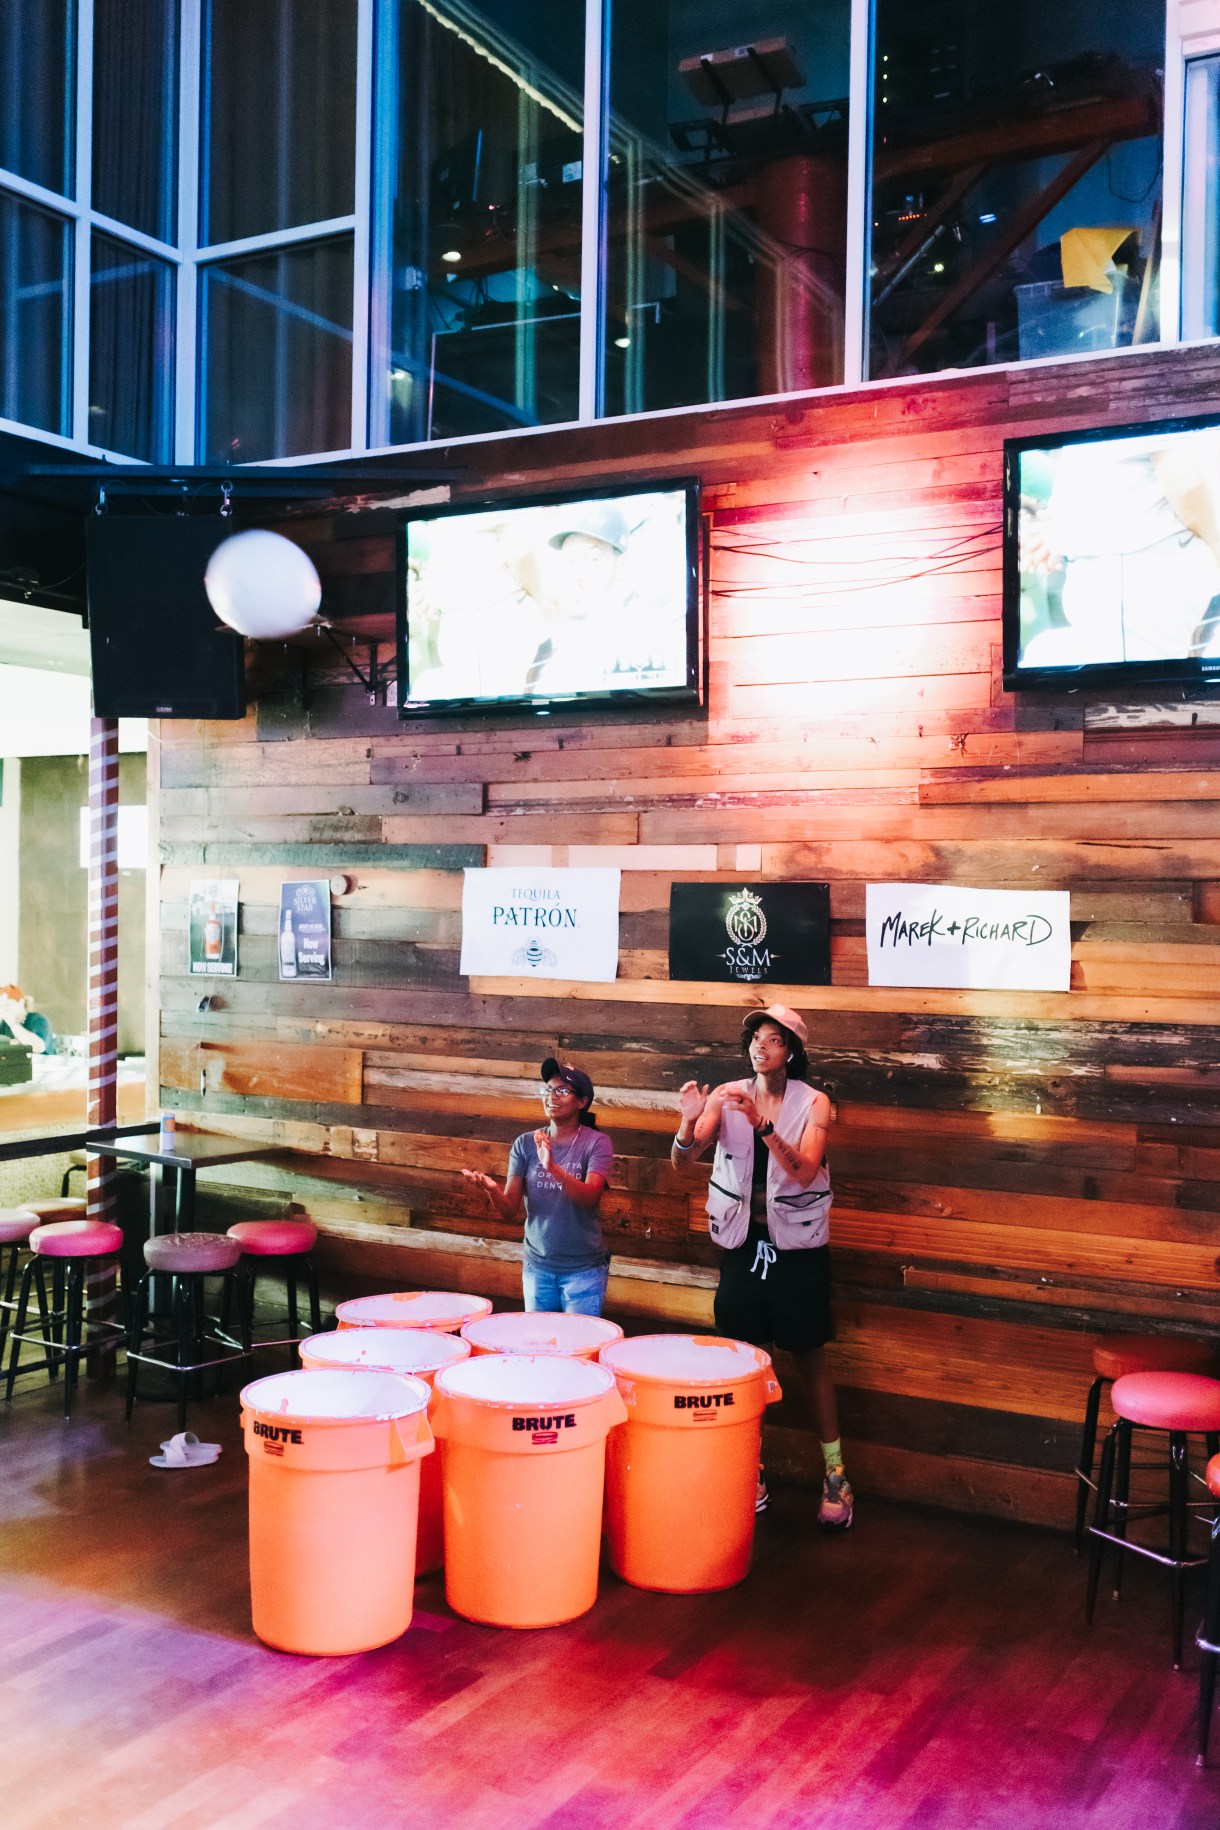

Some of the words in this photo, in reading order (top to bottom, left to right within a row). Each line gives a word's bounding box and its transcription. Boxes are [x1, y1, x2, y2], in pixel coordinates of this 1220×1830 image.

[294, 896, 317, 905] SILVER
[512, 888, 560, 901] TEQUILA
[493, 903, 577, 927] PATRÓN
[303, 938, 319, 949] Now
[298, 951, 325, 966] Serving
[726, 947, 772, 967] S&M
[192, 961, 207, 973] NOW
[729, 966, 768, 974] JEWELS
[674, 1392, 734, 1409] BRUTE
[512, 1413, 576, 1431] BRUTE
[253, 1420, 303, 1445] BRUTE
